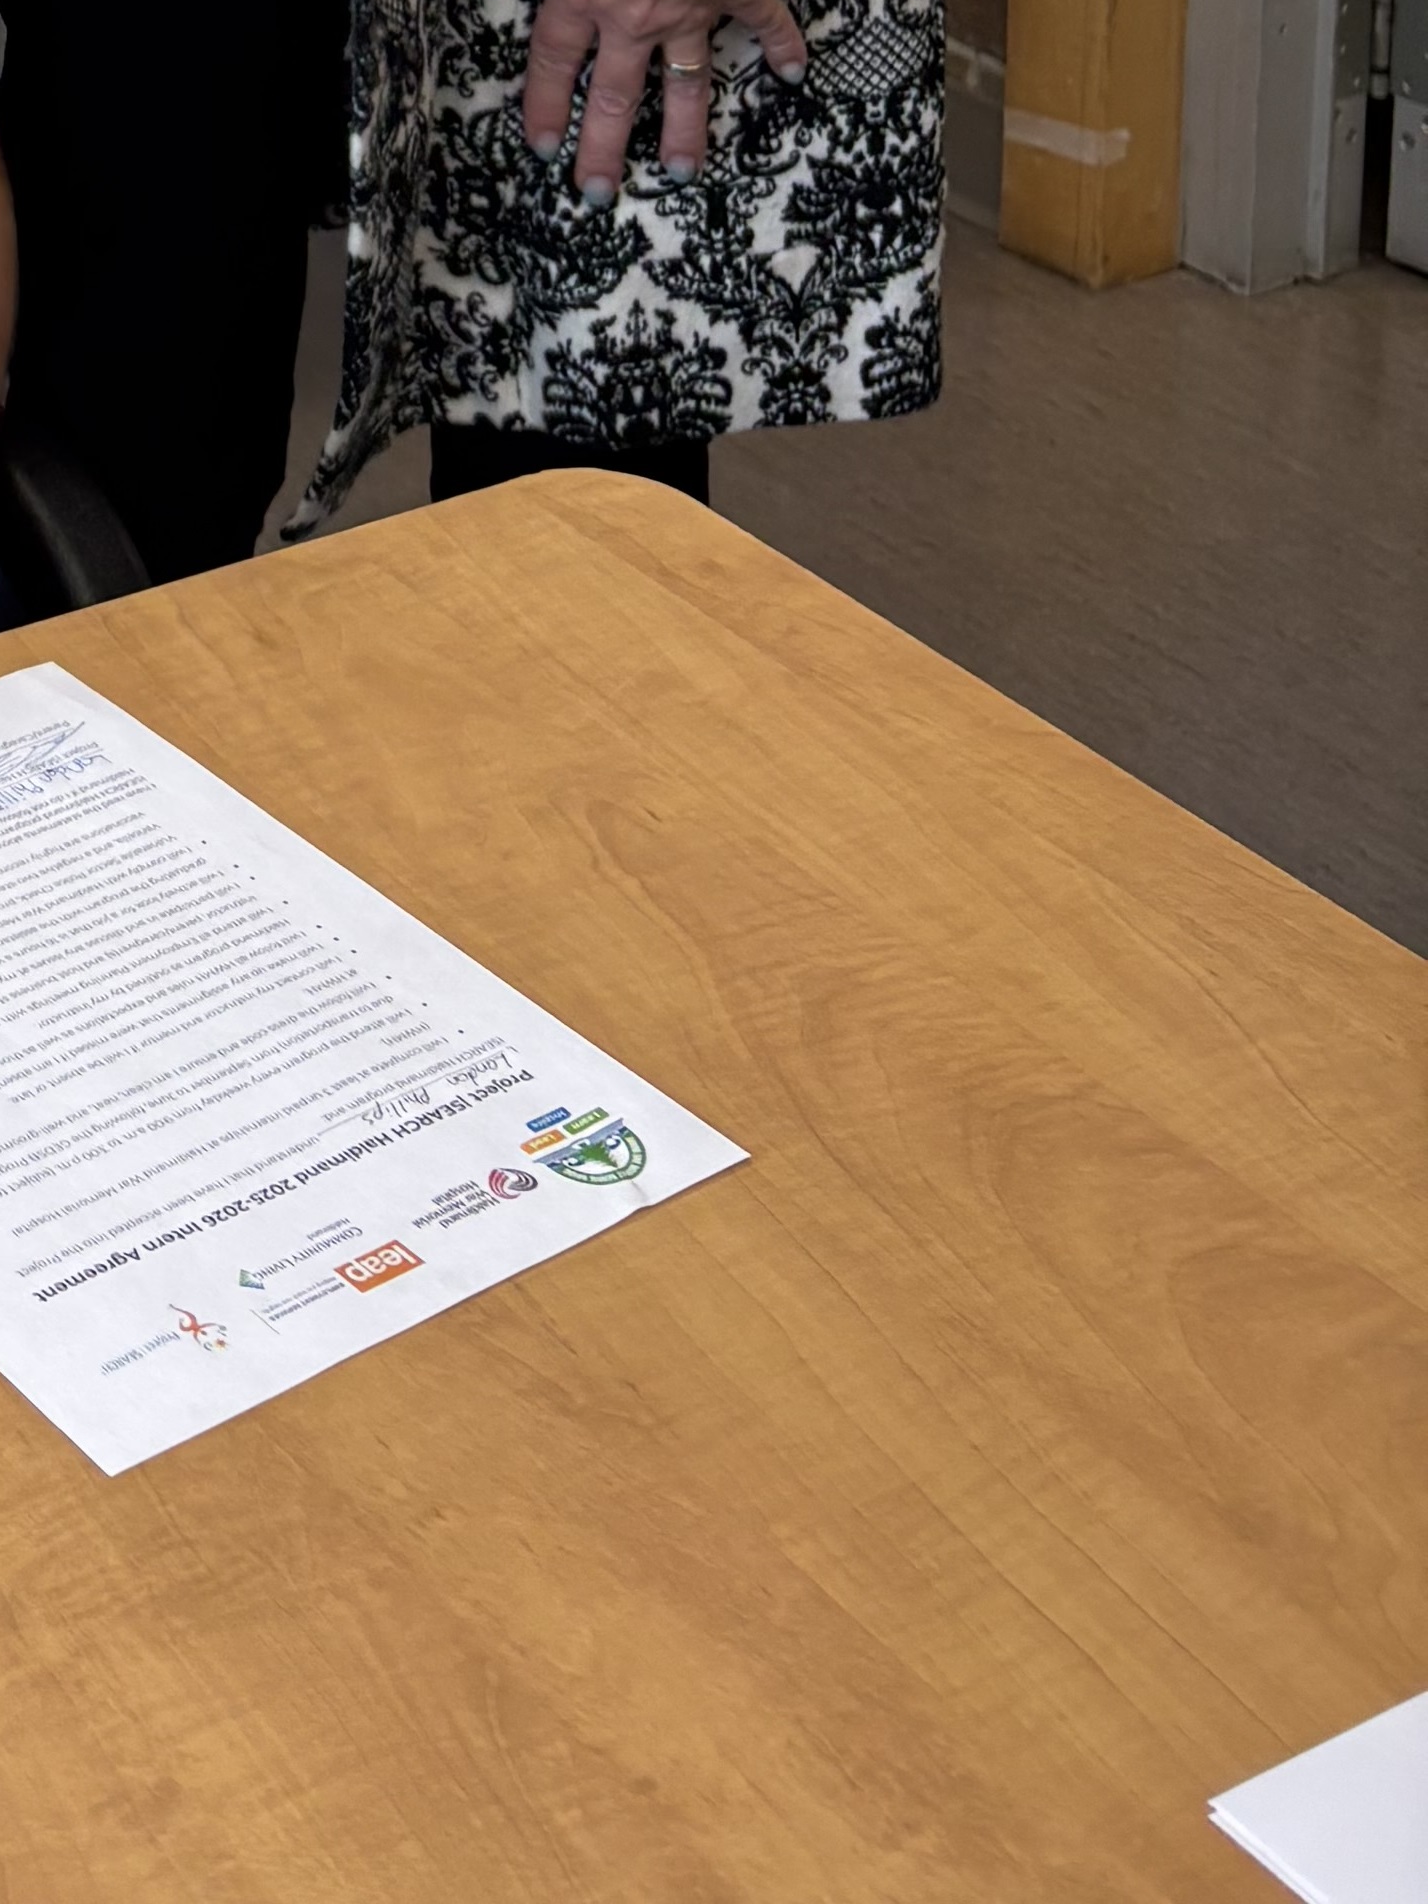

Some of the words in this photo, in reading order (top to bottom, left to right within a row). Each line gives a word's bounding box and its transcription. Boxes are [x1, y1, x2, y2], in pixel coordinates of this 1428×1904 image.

[445, 1052, 512, 1086] Landon
[467, 1069, 533, 1101] Project
[360, 1085, 429, 1124] Phillips
[293, 1132, 392, 1184] Haldimand
[201, 1179, 295, 1226] 2025-2026
[431, 1180, 479, 1206] Hospital
[464, 1188, 490, 1202] War
[411, 1199, 465, 1228] Memorial
[438, 1194, 499, 1228] Haldimand
[141, 1221, 202, 1251] Intern
[33, 1248, 139, 1301] Agreement
[345, 1245, 415, 1281] leap
